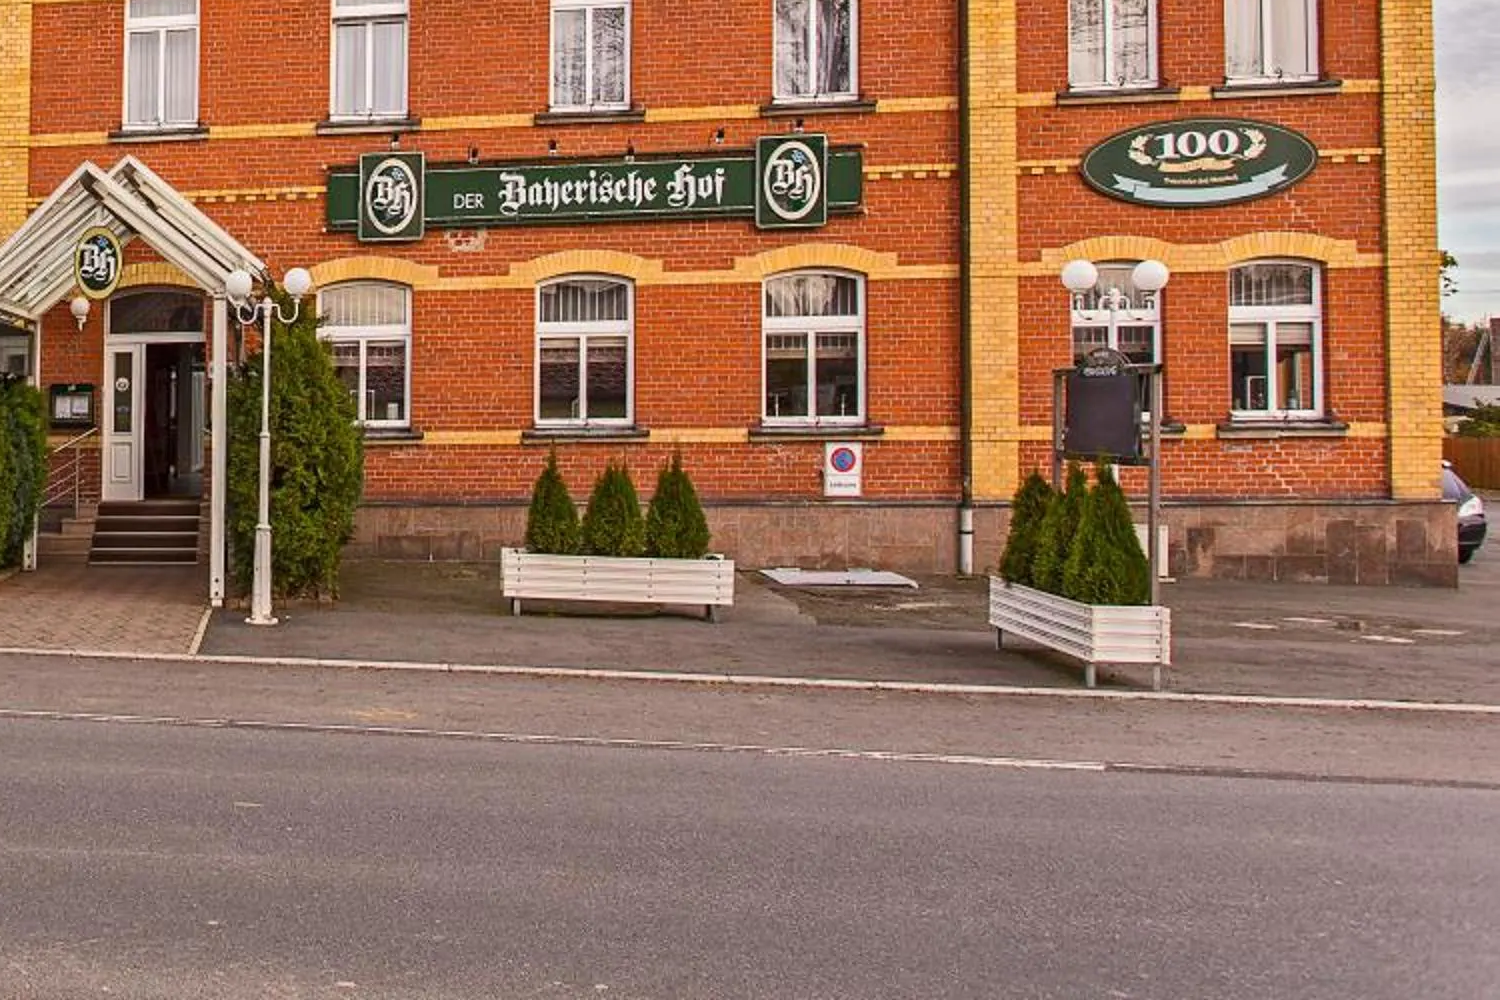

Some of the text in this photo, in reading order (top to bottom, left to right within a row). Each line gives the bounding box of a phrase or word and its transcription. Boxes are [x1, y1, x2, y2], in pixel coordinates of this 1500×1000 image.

[1155, 129, 1240, 159] 100
[453, 163, 725, 216] DER Bayerische Hof
